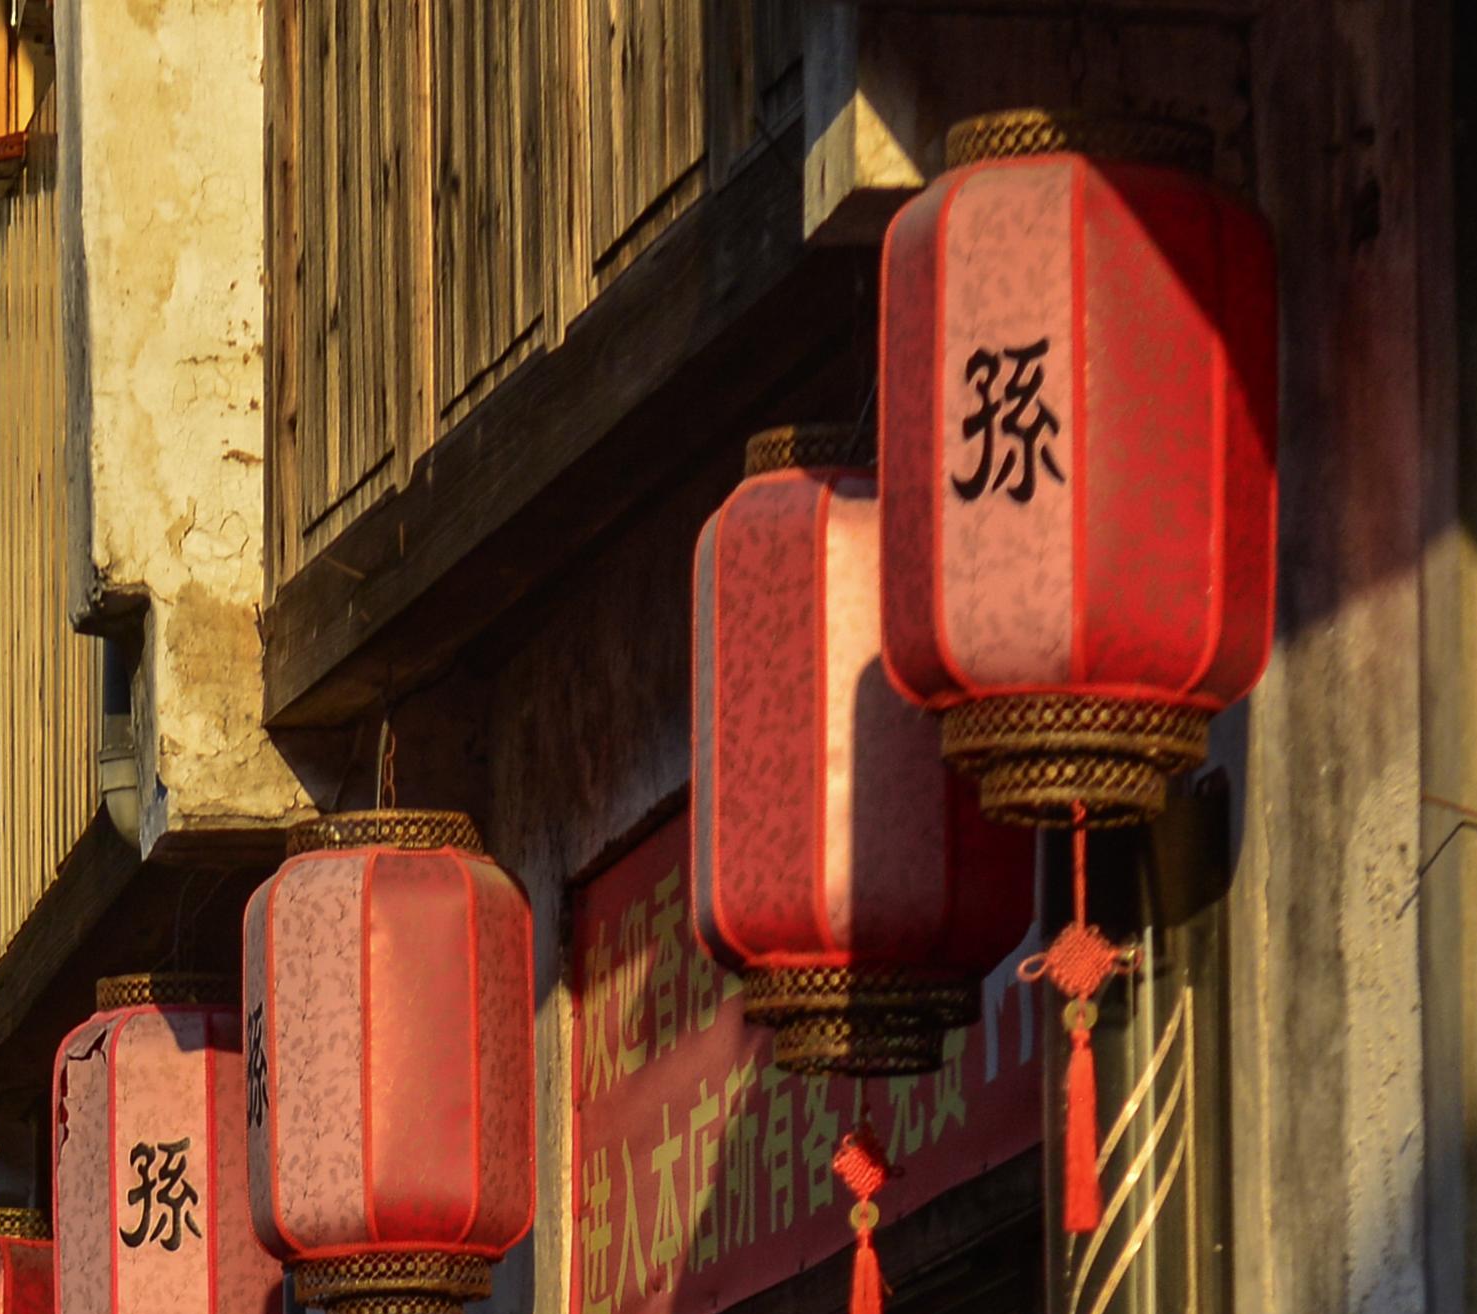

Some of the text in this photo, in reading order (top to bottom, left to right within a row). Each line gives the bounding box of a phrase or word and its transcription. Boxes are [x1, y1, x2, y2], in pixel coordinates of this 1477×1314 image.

[950, 337, 1066, 504] 孫
[581, 861, 745, 1103] 欢迎香港
[119, 1137, 203, 1252] 孫
